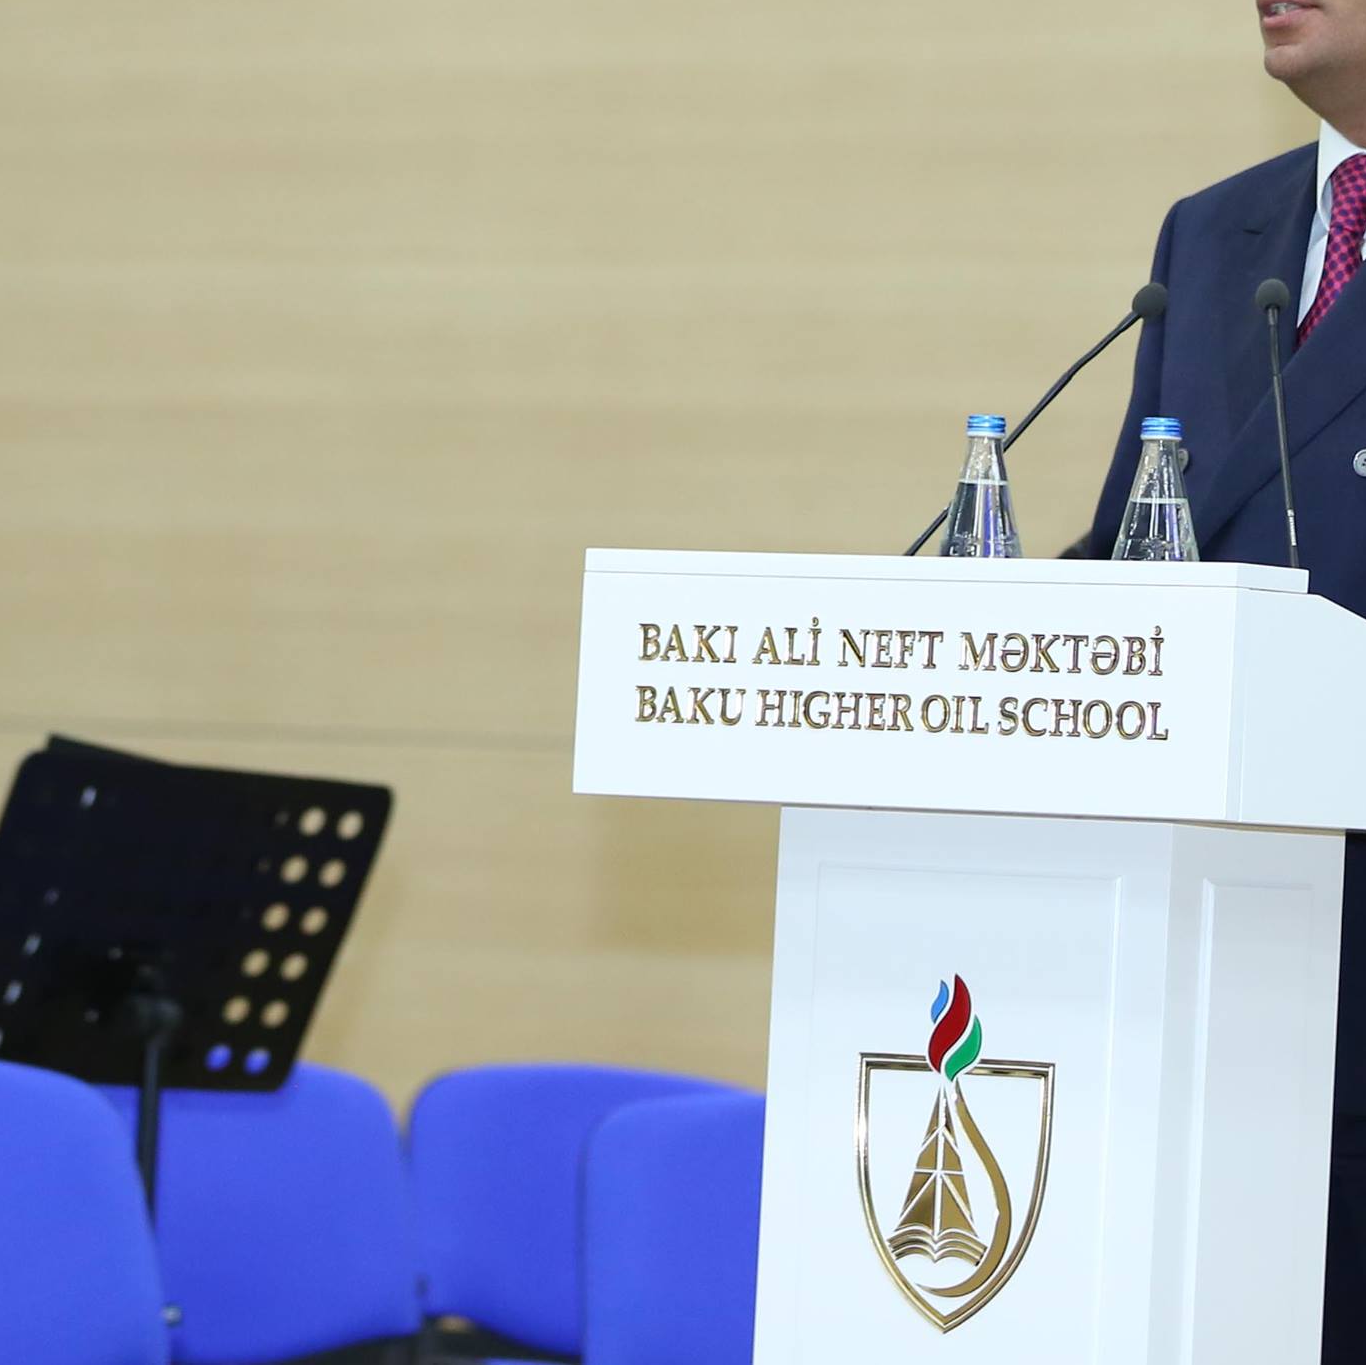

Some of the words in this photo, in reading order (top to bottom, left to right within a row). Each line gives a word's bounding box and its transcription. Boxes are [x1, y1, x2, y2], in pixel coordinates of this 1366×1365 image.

[638, 623, 738, 663] BAKI
[752, 616, 821, 665] ALİ
[837, 628, 944, 669] NEFT
[958, 625, 1164, 676] MƏKTƏBİ
[635, 685, 746, 726] BAKU
[755, 688, 914, 732] HIGHER
[921, 694, 989, 734] OIL
[997, 696, 1169, 740] SCHOOL
